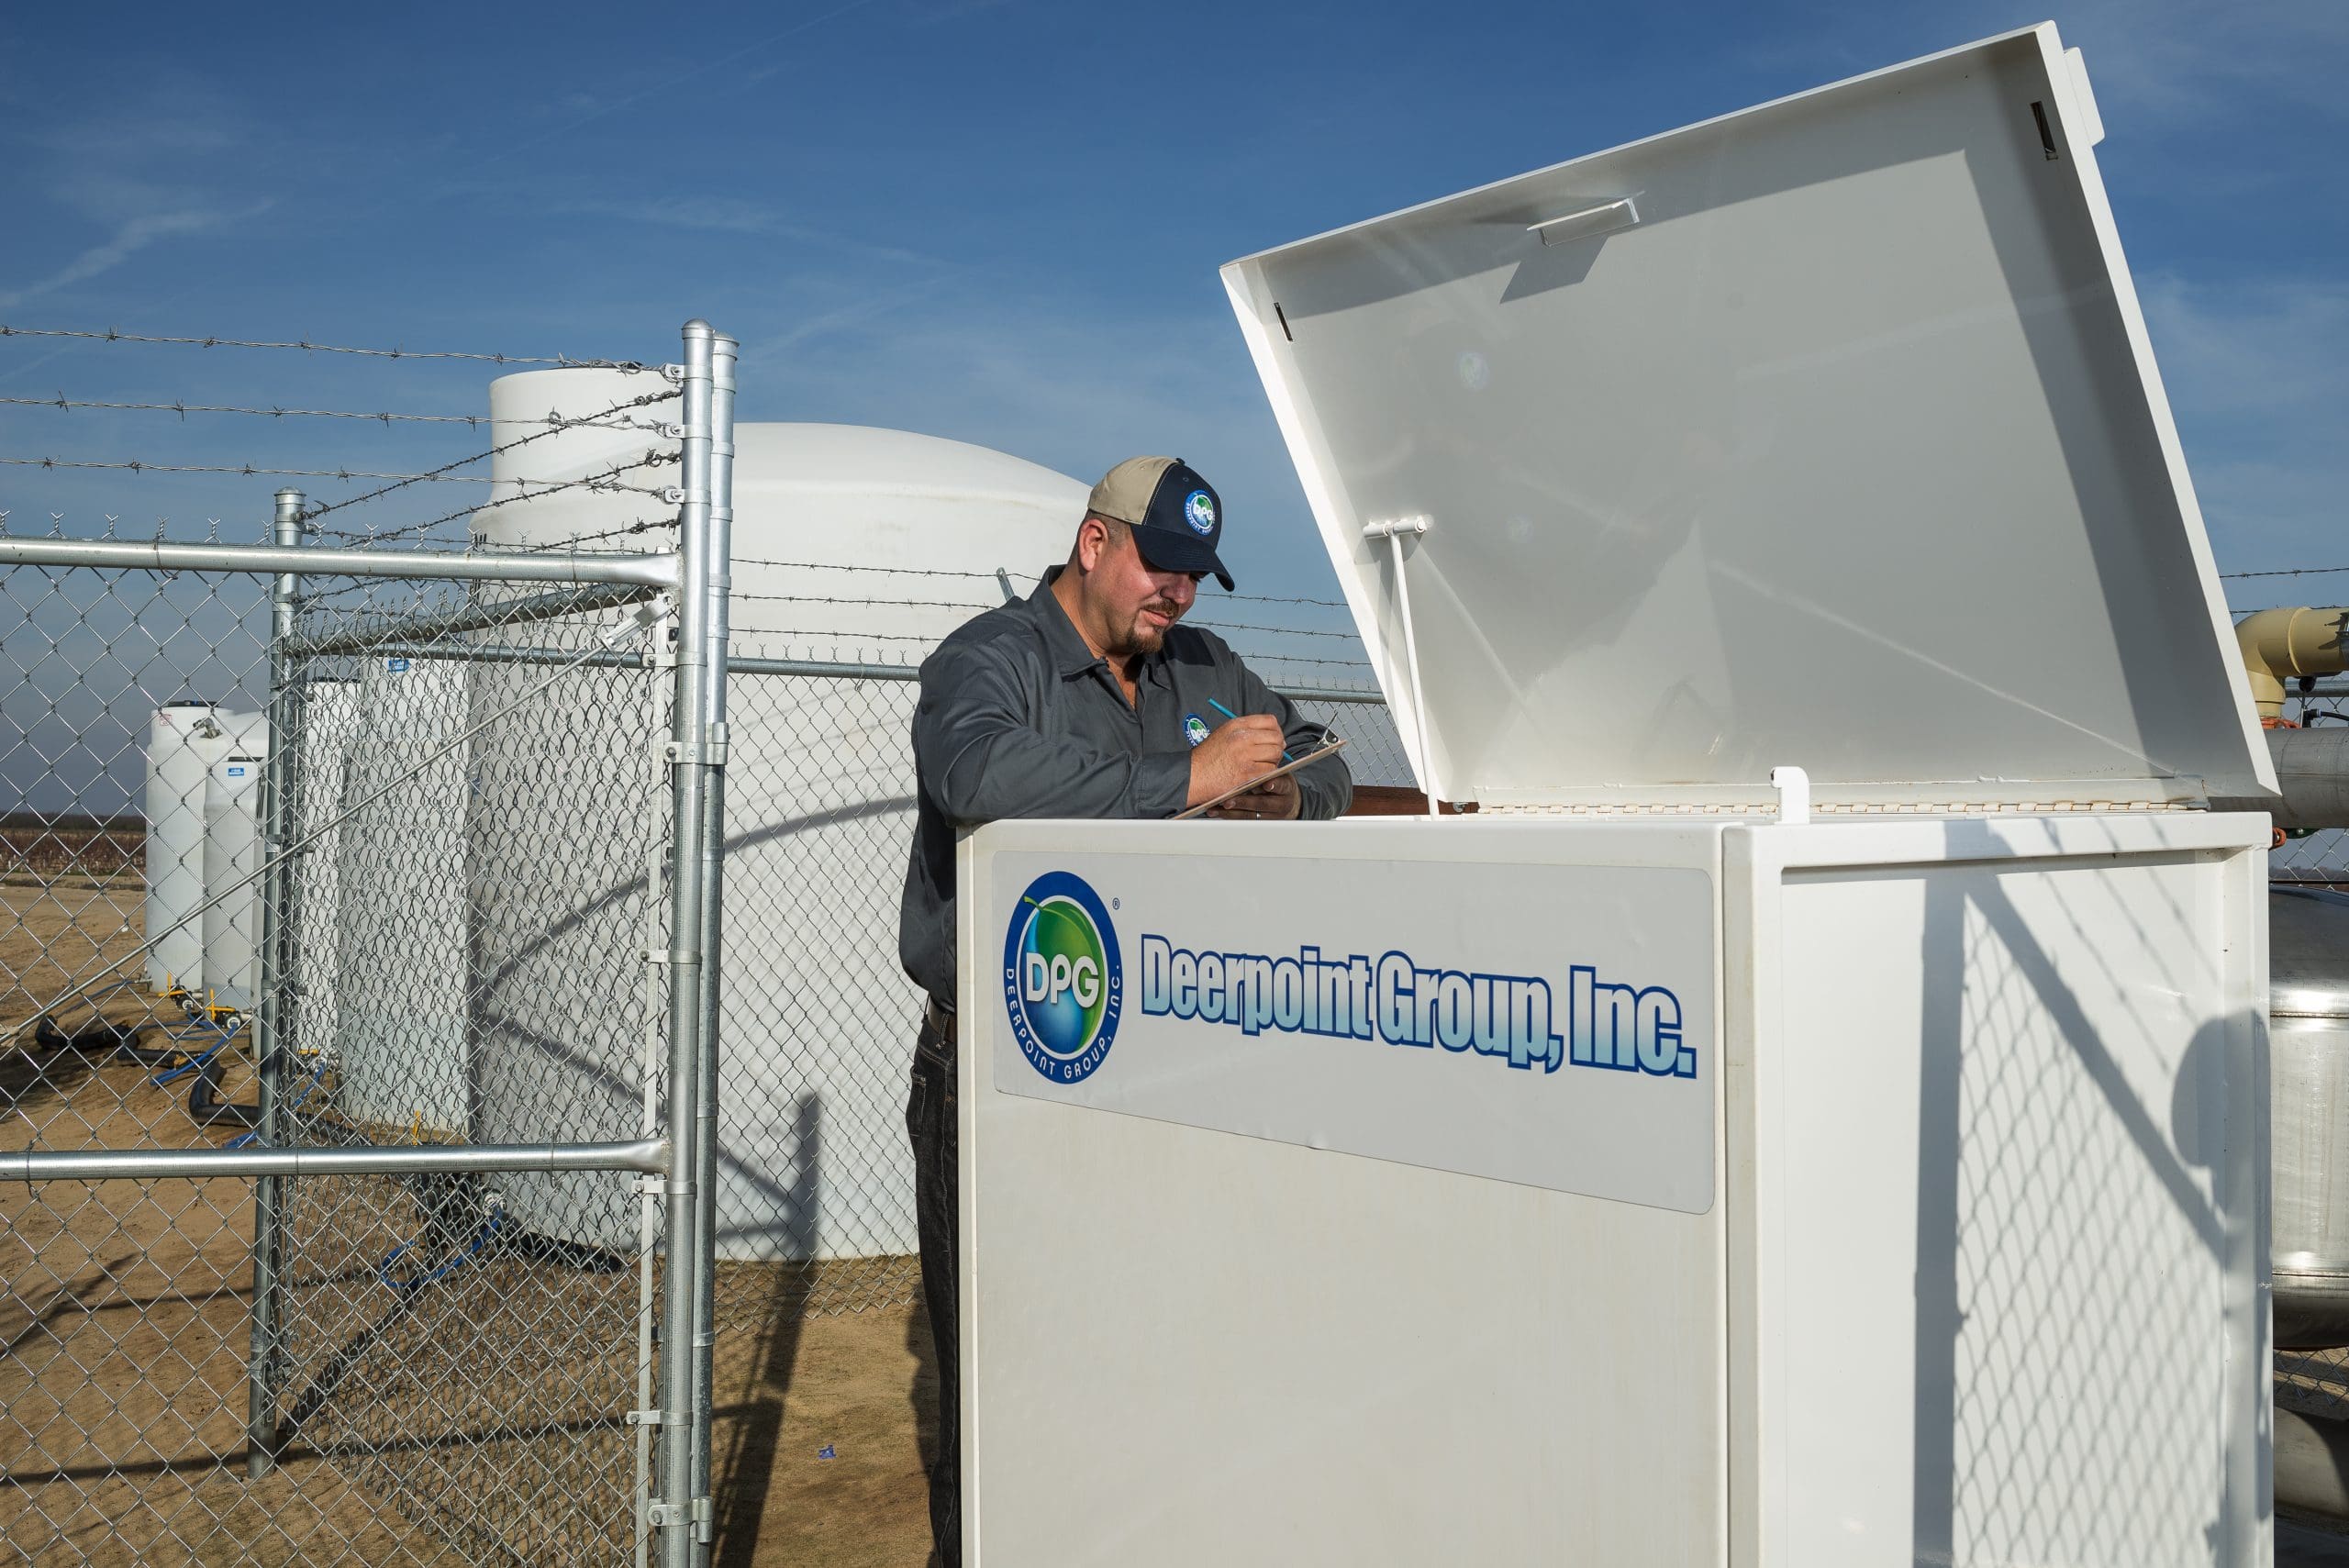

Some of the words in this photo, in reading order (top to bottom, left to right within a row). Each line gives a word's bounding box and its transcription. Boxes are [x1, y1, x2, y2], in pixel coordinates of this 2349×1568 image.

[1193, 505, 1213, 521] DPG
[1007, 968, 1055, 1075] DEERPOINT
[1064, 1035, 1112, 1079] GROUP,
[1108, 964, 1120, 1018] INC.
[1026, 952, 1099, 1008] DPG
[1141, 933, 1375, 1040] Deerpoint
[1376, 950, 1564, 1073] Group,
[1570, 965, 1697, 1078] Inc.
